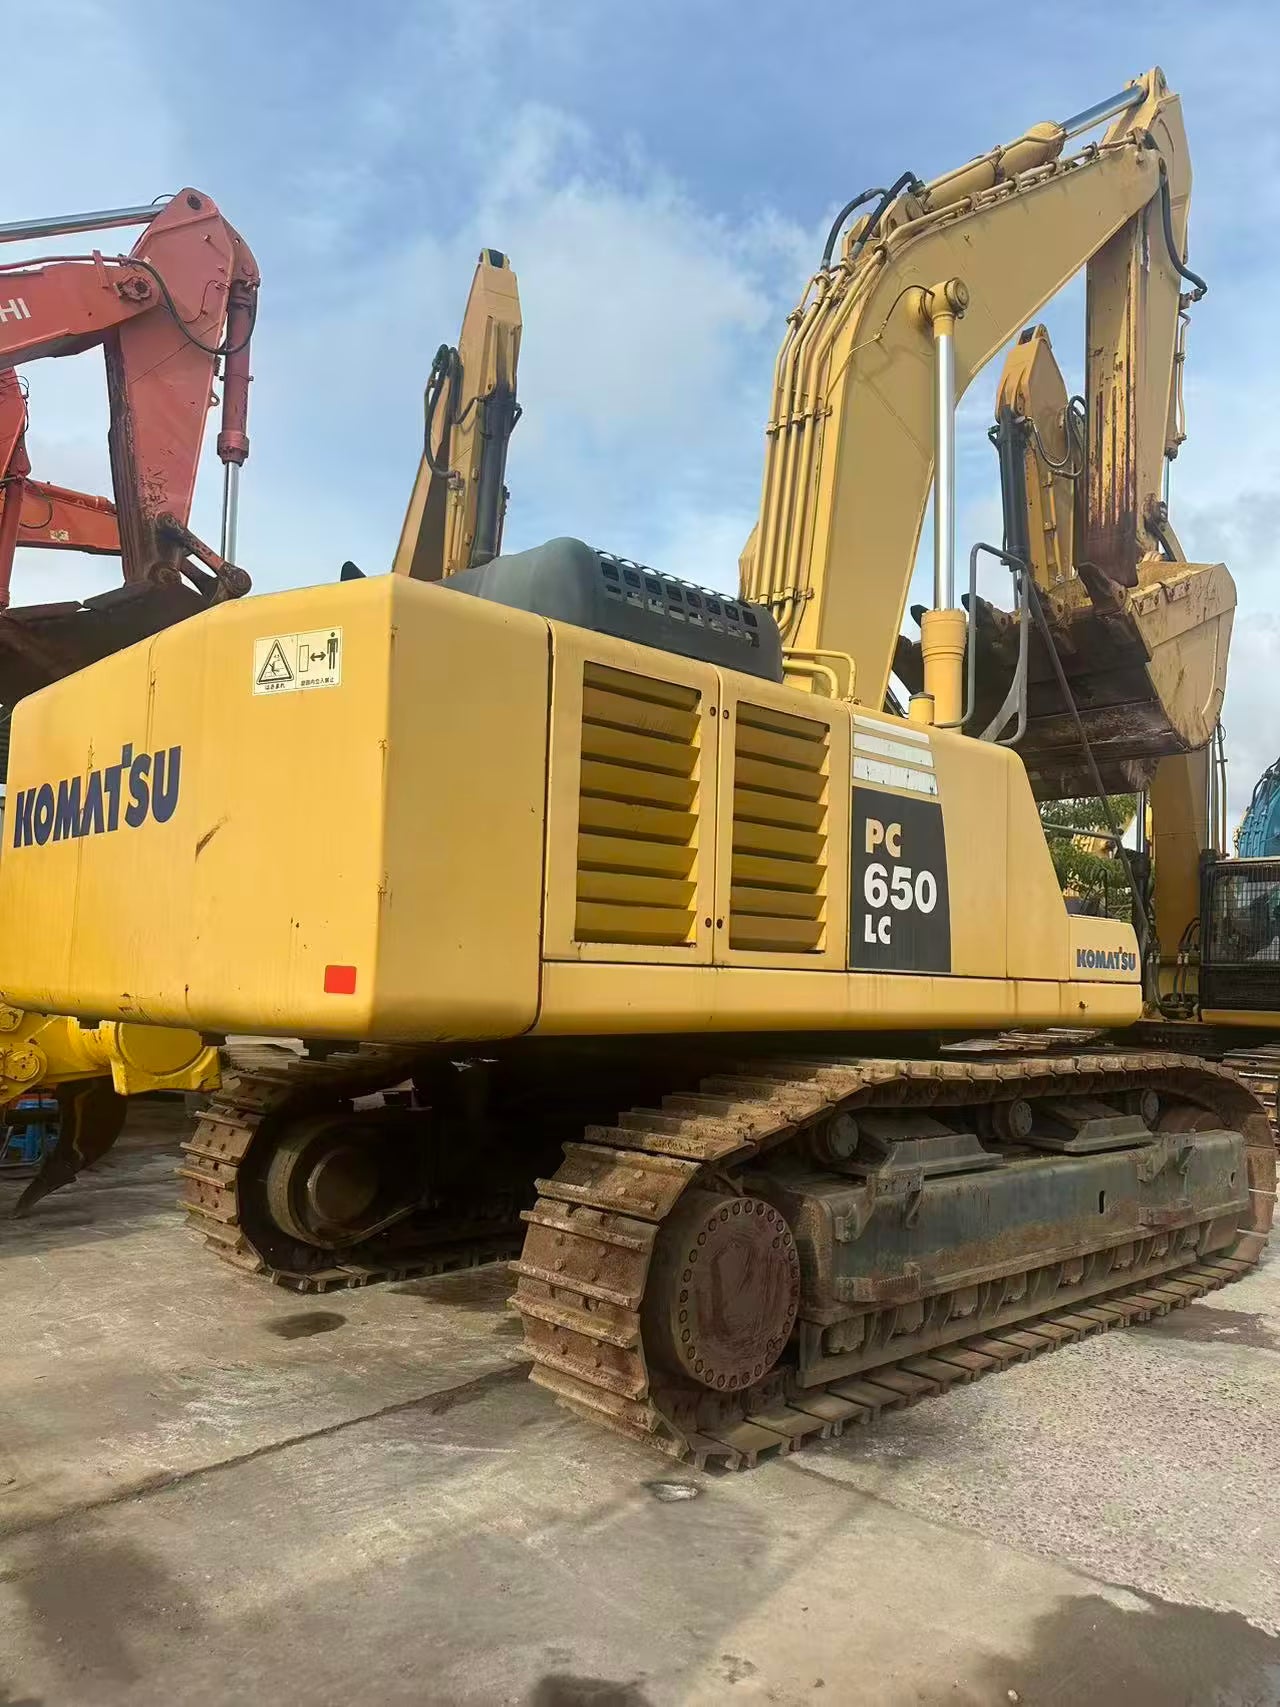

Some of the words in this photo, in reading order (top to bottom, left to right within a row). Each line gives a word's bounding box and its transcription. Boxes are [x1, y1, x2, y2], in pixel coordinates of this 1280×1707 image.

[13, 742, 182, 848] KOMATSU
[865, 817, 902, 857] PC
[864, 862, 937, 914] 650
[864, 914, 892, 944] LC
[1076, 946, 1136, 971] KOMATSU
